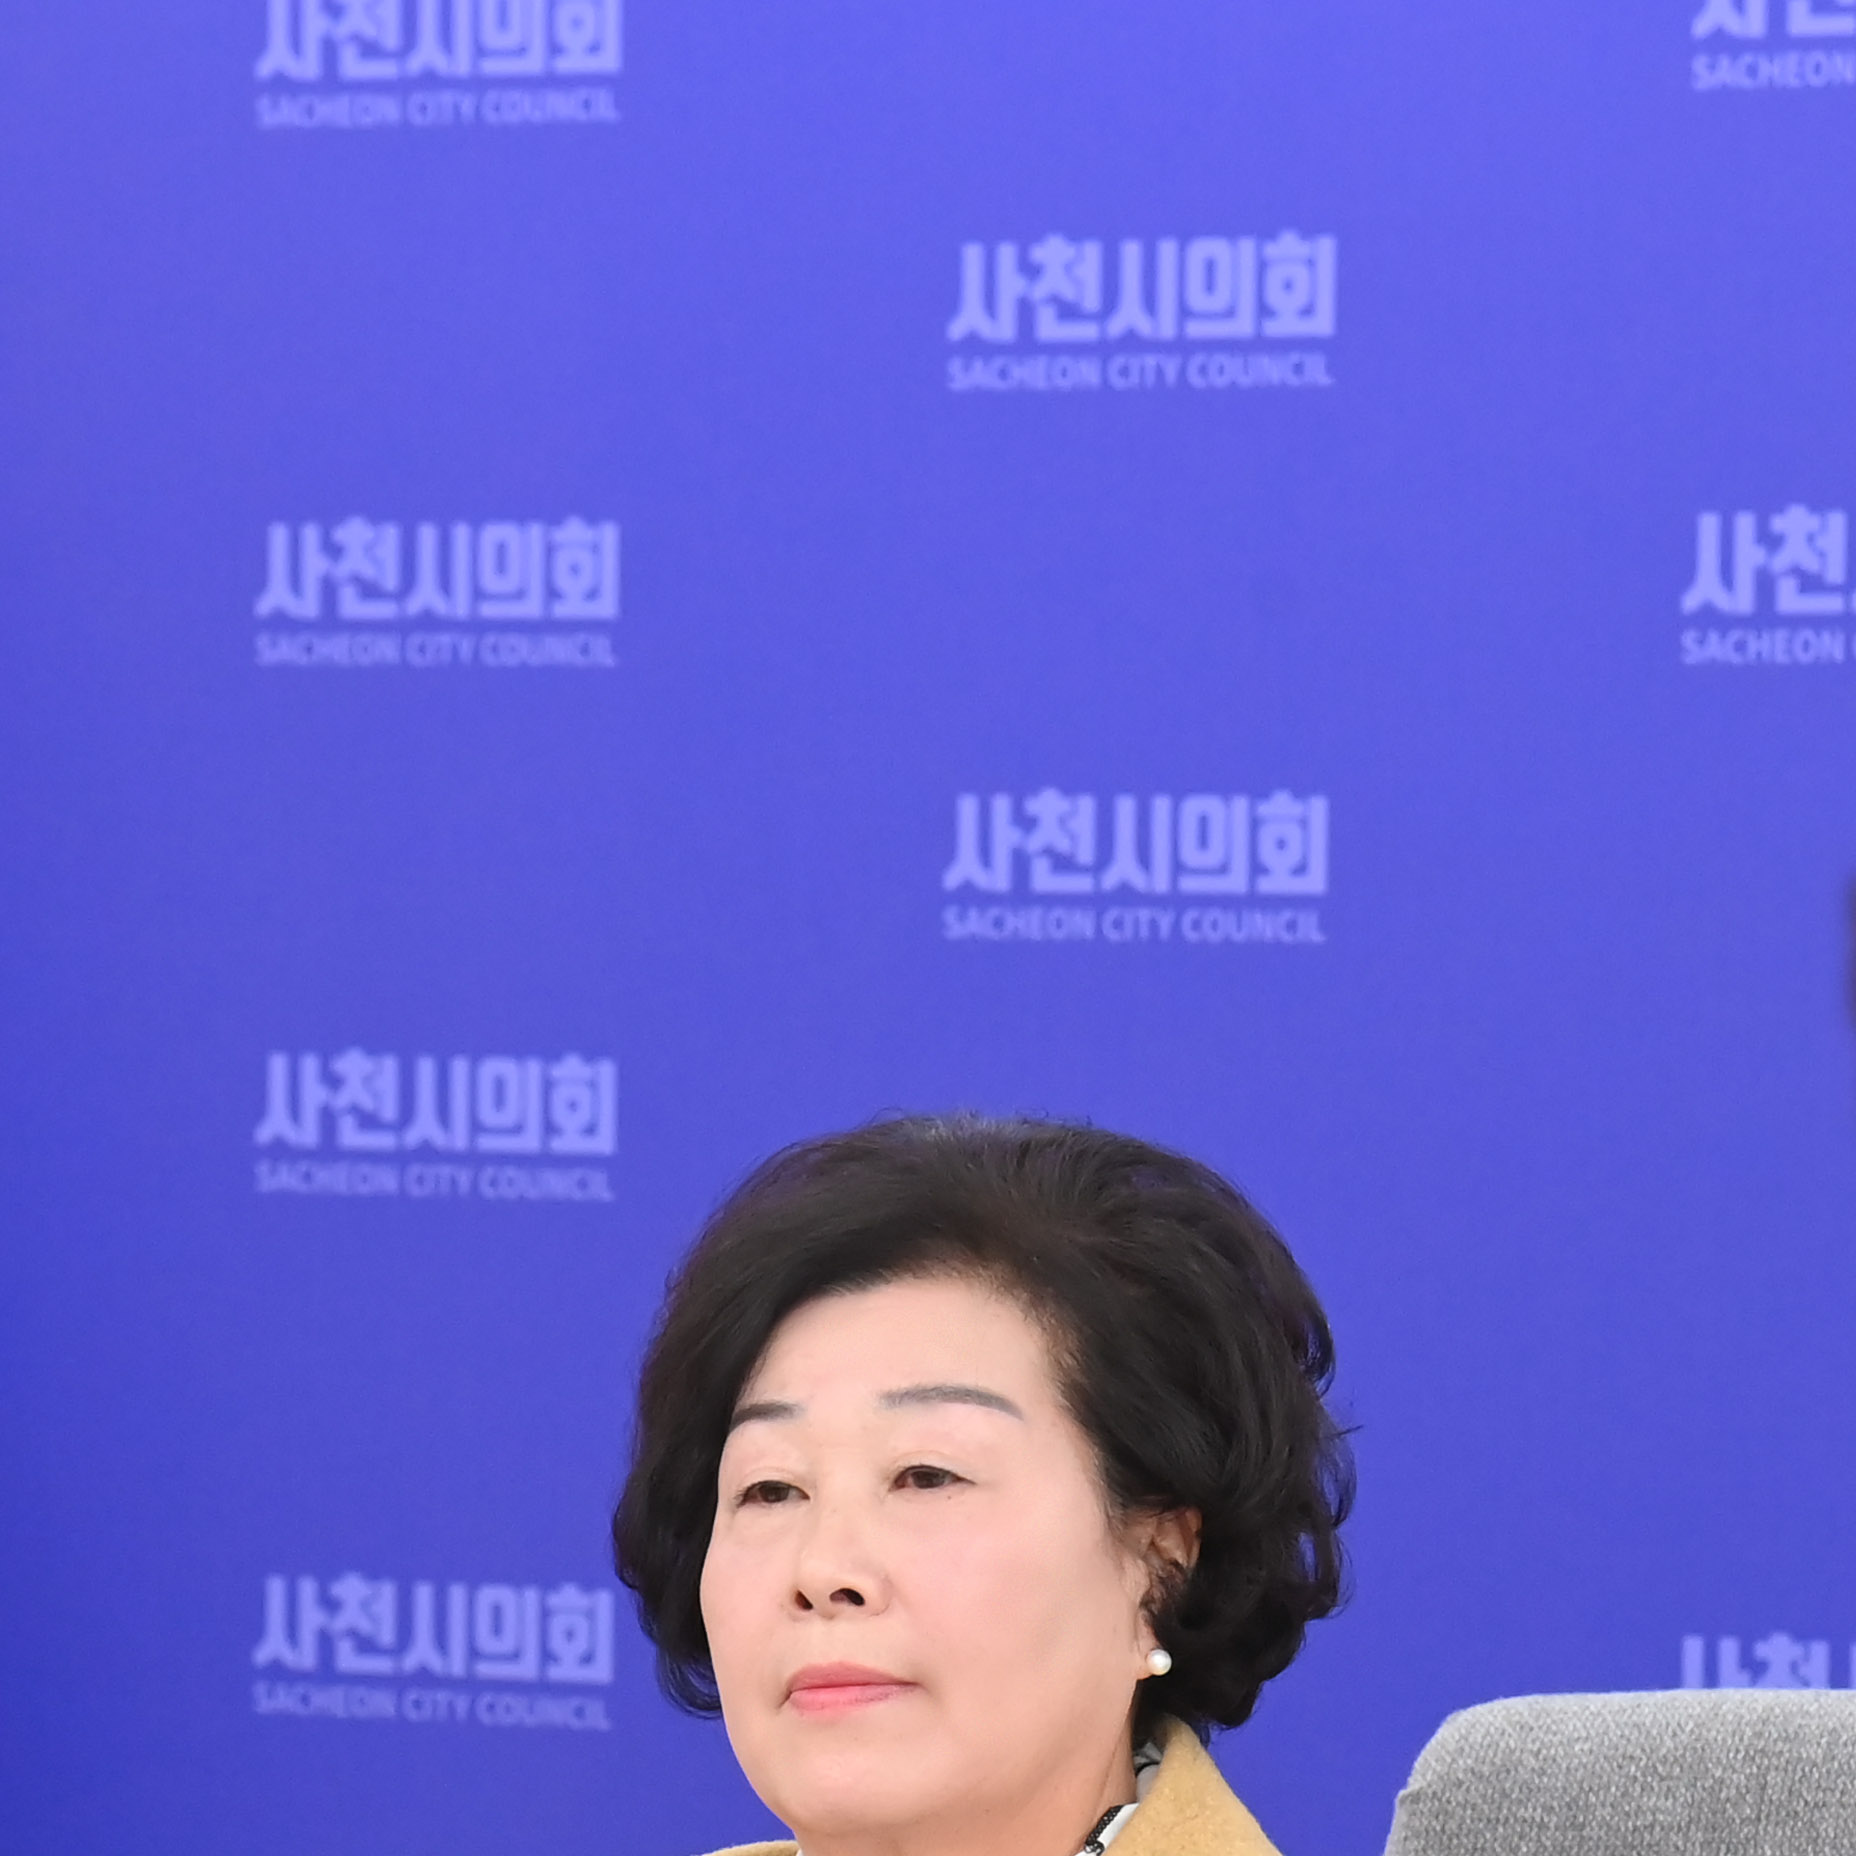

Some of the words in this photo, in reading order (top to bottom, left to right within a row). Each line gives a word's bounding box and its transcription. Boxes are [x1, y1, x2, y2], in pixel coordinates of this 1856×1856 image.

[947, 231, 1336, 342] 사천시의회
[947, 355, 1102, 392] SACHEON
[1107, 353, 1182, 390] CITY
[1187, 351, 1335, 389] COUNCIL
[255, 516, 619, 620] 사천시의회
[1681, 628, 1845, 665] SACHEON
[943, 788, 1328, 895] 사천시의회
[942, 905, 1096, 941] SACHEON
[1101, 906, 1175, 943] CITY
[1181, 907, 1326, 944] COUNCIL
[255, 1049, 616, 1155] 사천시의회
[253, 1573, 614, 1684] 사천시의회
